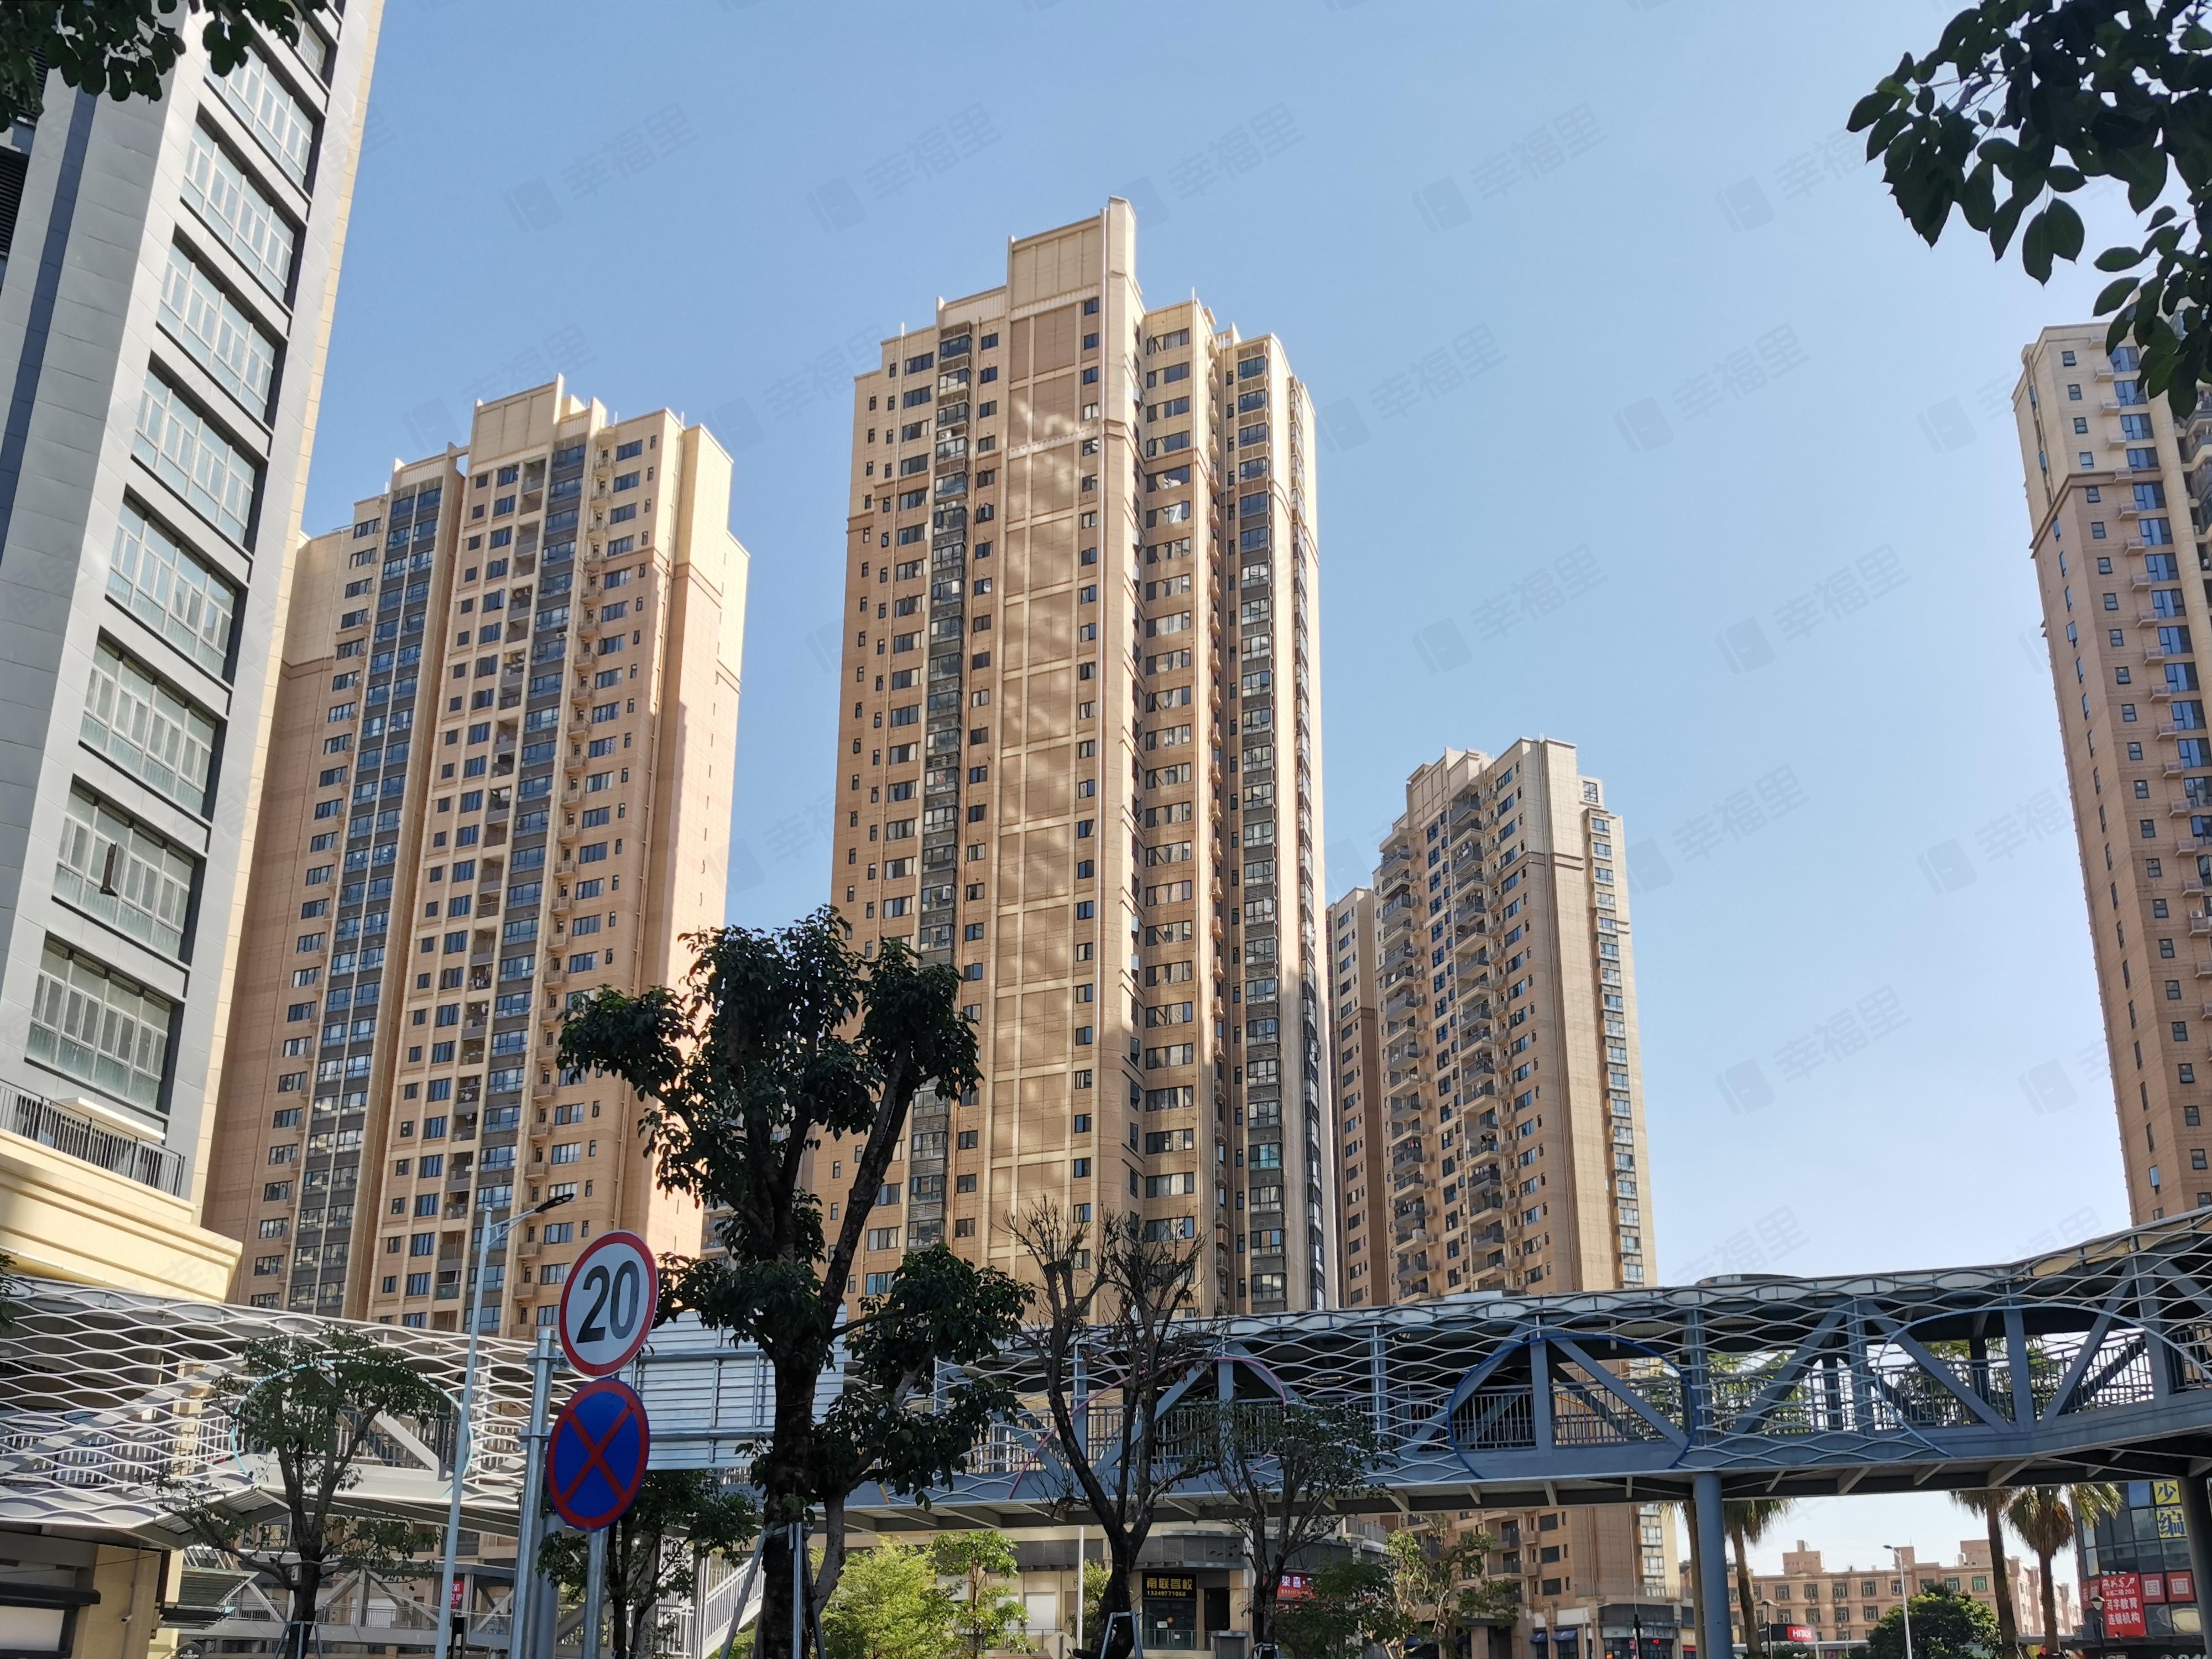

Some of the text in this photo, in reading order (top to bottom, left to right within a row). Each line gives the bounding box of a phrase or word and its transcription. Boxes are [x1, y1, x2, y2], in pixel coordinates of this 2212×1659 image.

[576, 1260, 640, 1344] 20
[2157, 1482, 2177, 1504] 少
[2157, 1510, 2185, 1536] 编
[1146, 1578, 1193, 1590] 南联驾校
